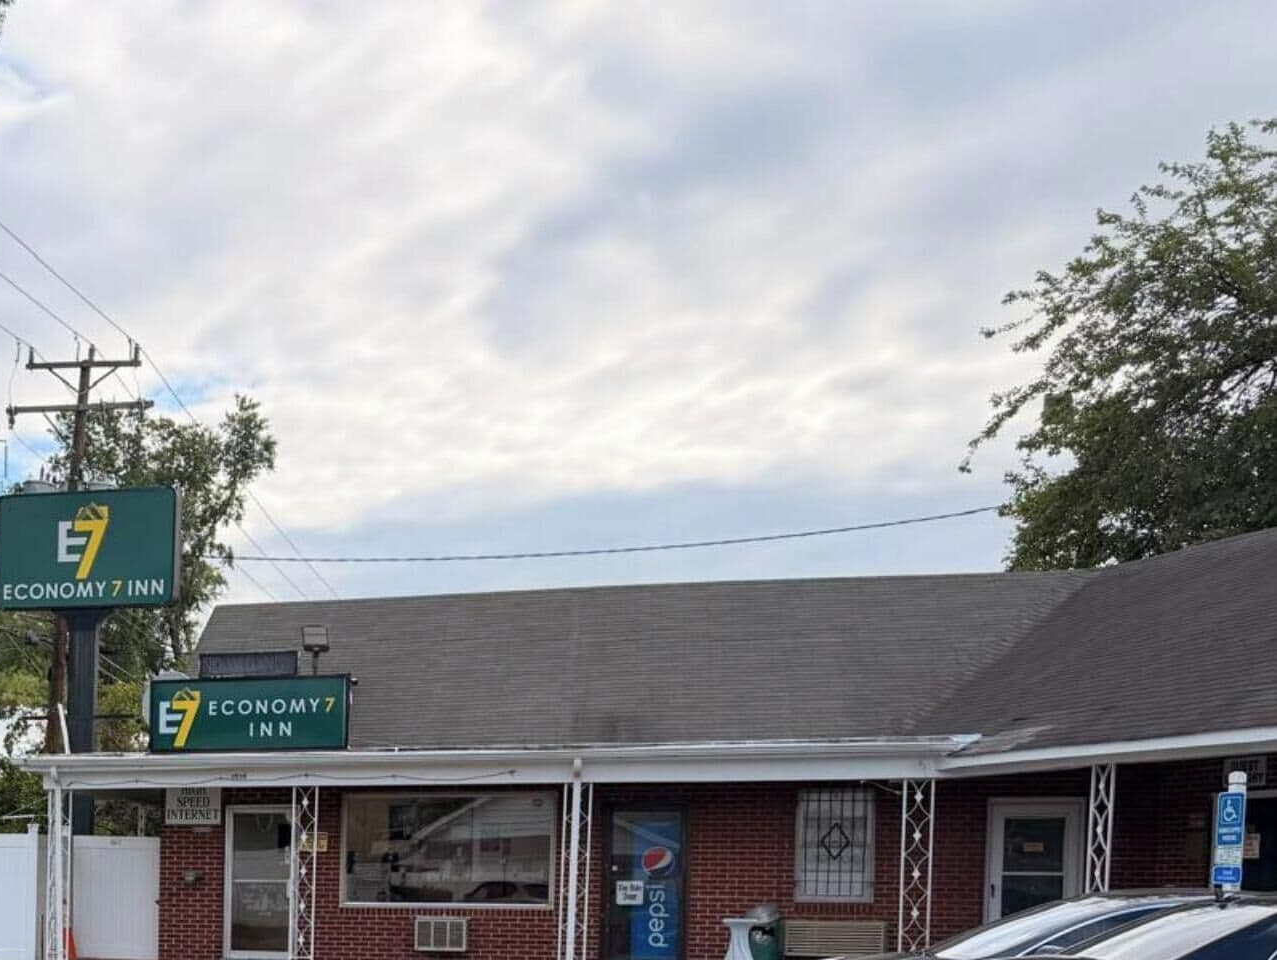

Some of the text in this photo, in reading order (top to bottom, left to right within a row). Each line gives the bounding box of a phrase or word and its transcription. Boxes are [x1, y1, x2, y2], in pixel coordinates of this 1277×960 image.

[58, 503, 110, 580] E7
[3, 579, 165, 601] ECONOMY 7 INN
[208, 698, 336, 716] ECONOMY 7
[159, 688, 201, 748] E7
[249, 721, 293, 737] INN
[177, 796, 210, 808] SPEED
[167, 808, 220, 820] INTERNET
[647, 884, 671, 948] pepsi
